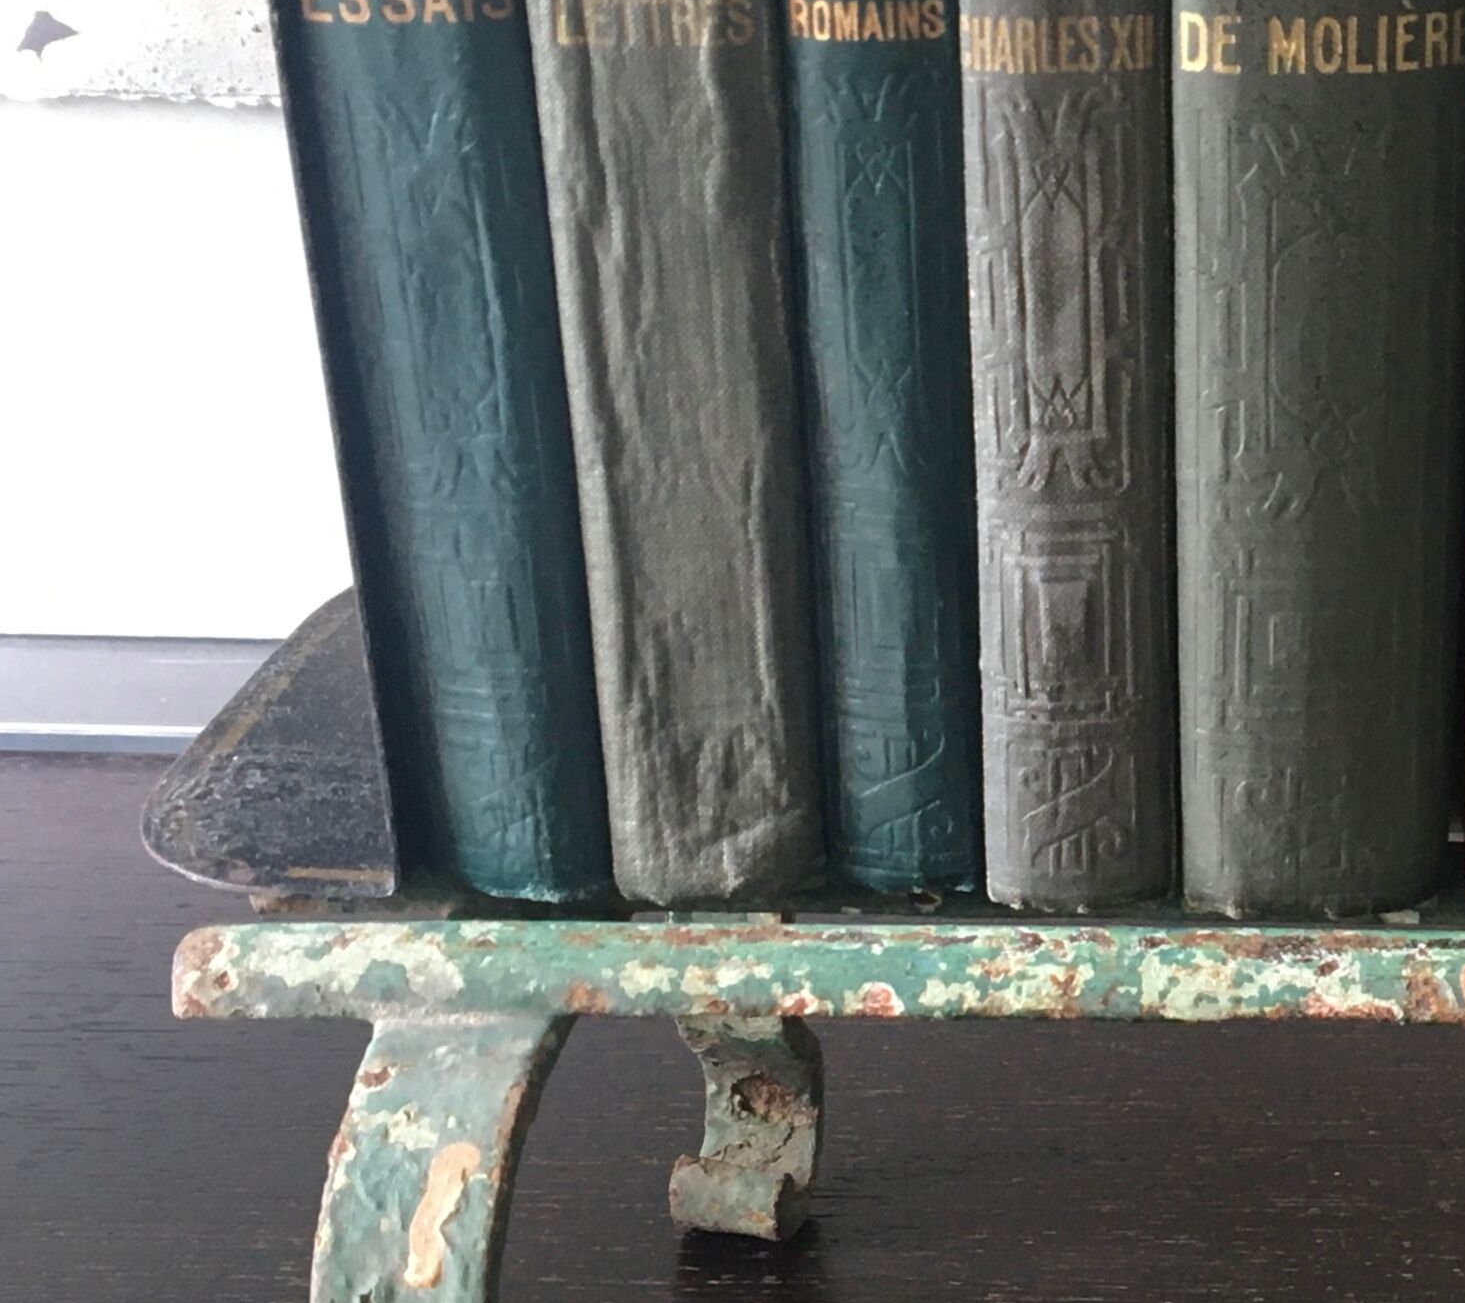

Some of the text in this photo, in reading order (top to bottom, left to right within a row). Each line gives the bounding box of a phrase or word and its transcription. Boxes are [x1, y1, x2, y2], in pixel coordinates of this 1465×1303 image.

[959, 14, 1154, 74] CHARLES XII
[1179, 11, 1242, 74] DE
